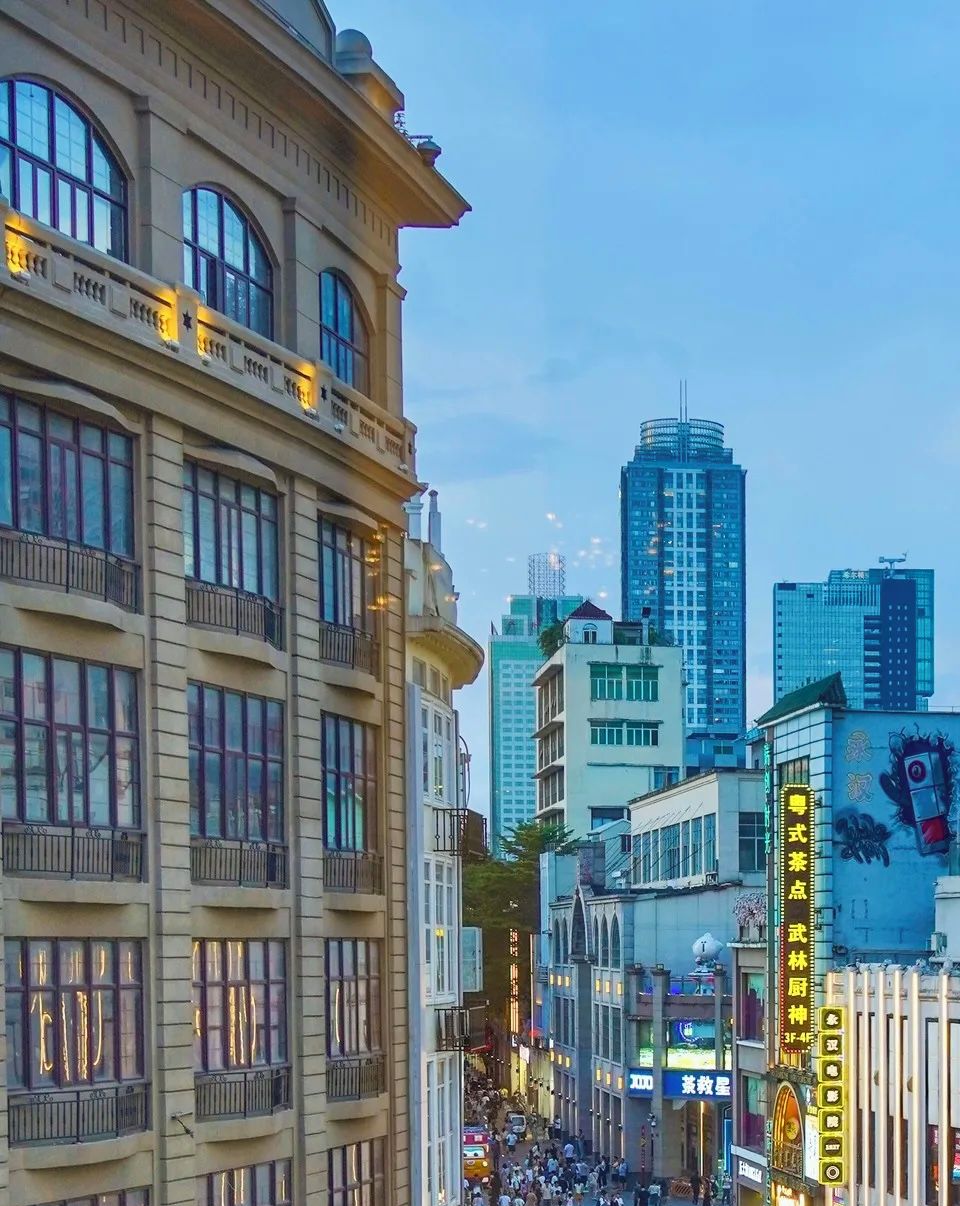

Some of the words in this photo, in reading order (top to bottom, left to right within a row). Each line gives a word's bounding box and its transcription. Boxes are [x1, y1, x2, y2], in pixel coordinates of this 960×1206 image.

[788, 794, 808, 900] 粤式茶点
[788, 923, 808, 1025] 武林厨神
[784, 1032, 812, 1044] 3F-4F
